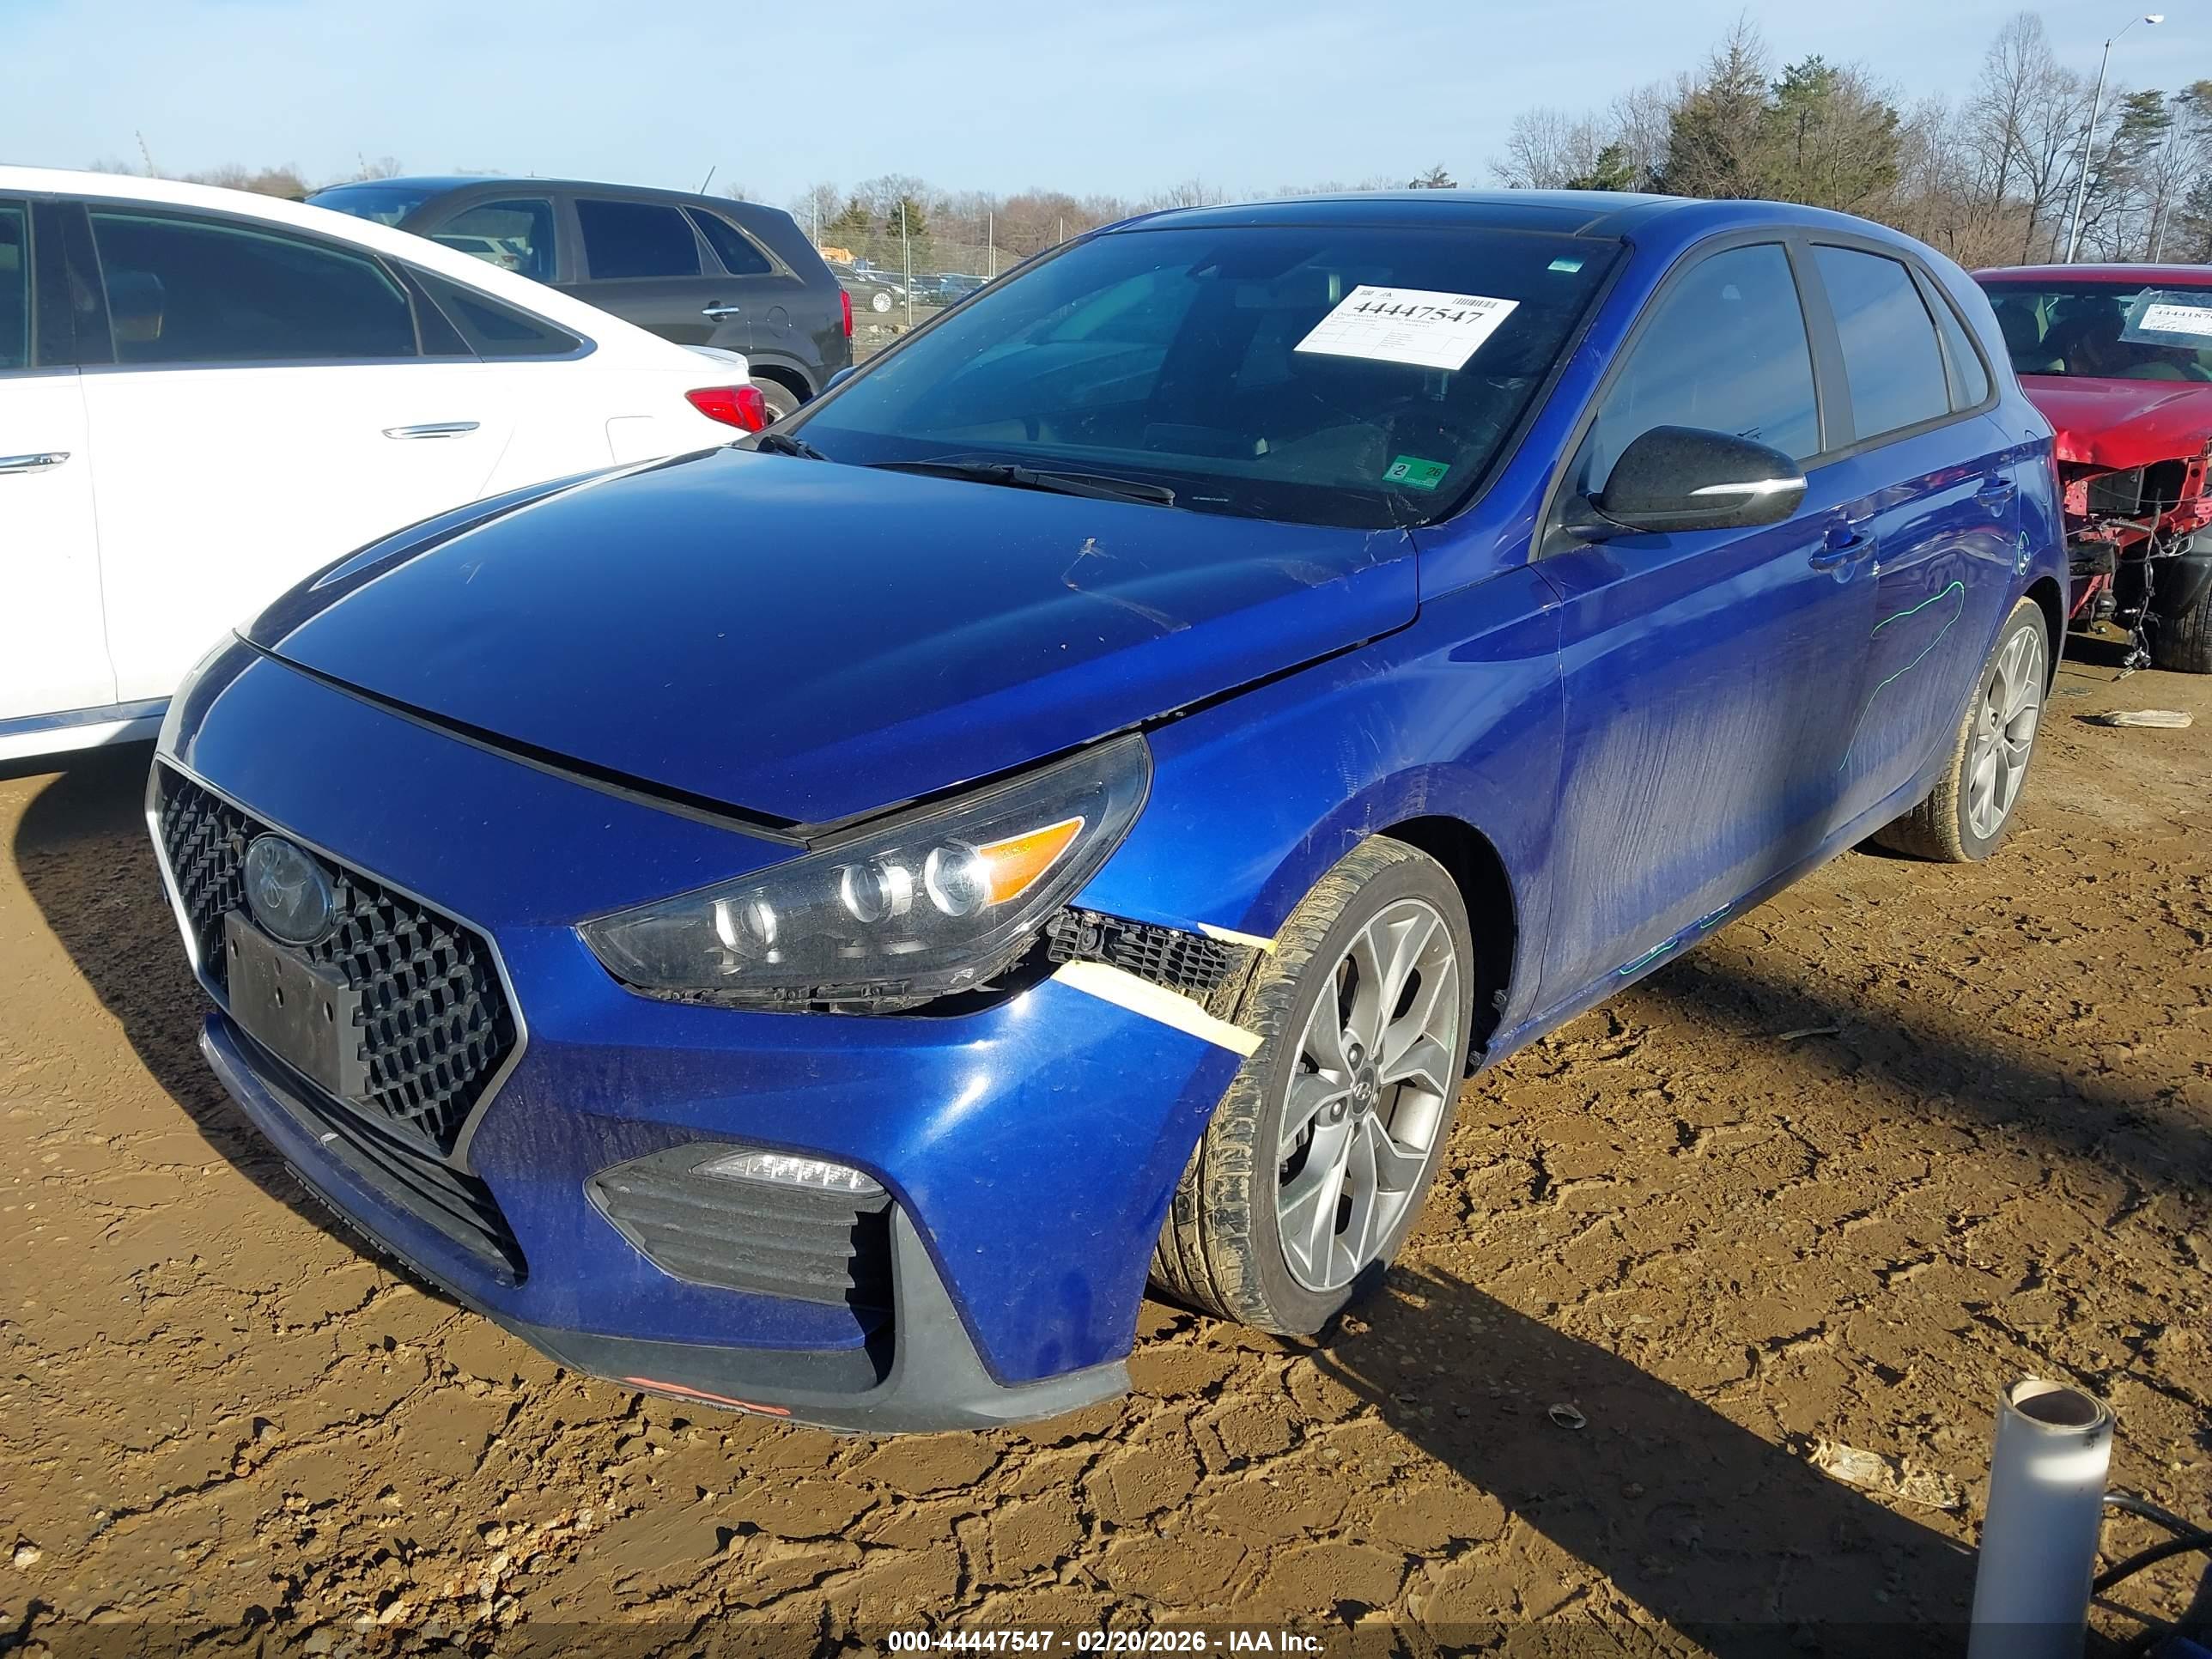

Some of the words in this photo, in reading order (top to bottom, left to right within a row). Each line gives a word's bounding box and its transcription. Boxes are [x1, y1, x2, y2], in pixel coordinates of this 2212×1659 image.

[1353, 301, 1484, 325] 44447547
[1394, 465, 1406, 476] 2
[1426, 466, 1443, 477] 26
